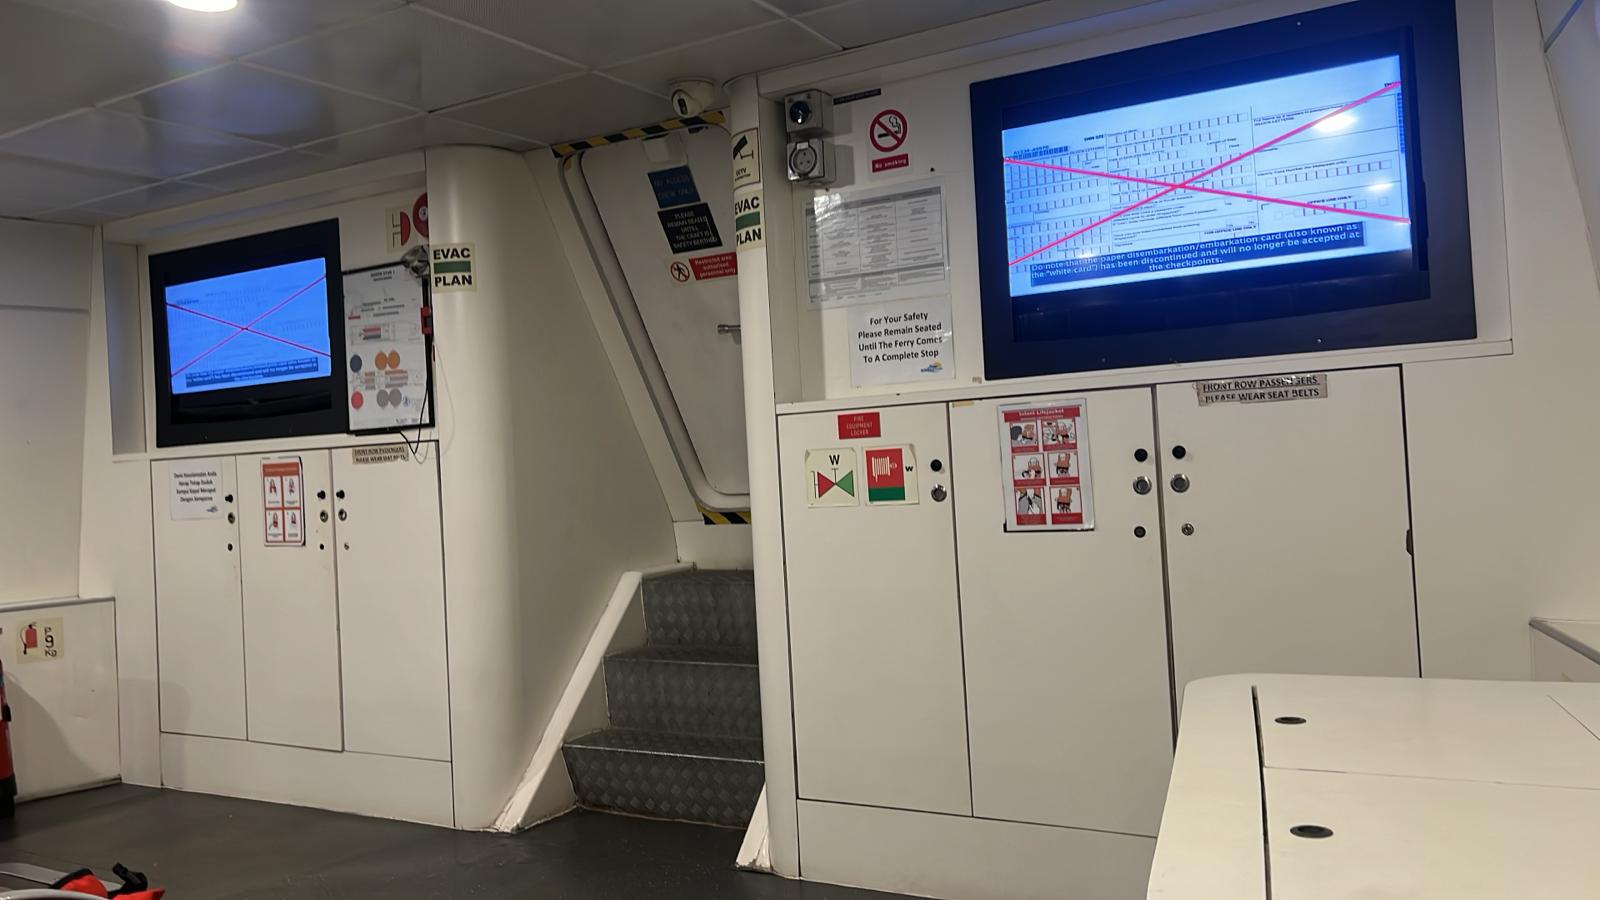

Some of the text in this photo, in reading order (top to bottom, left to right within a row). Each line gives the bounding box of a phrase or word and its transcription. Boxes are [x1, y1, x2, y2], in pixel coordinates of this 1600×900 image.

[735, 196, 760, 215] EVAC
[434, 248, 470, 260] EVAC
[1046, 262, 1064, 270] note
[1066, 259, 1082, 268] that
[1083, 257, 1098, 265] the
[1101, 254, 1125, 264] paper
[1260, 232, 1282, 242] card
[1284, 228, 1308, 240] (also
[1310, 225, 1343, 236] known
[1032, 270, 1044, 278] the
[1100, 262, 1115, 270] has
[1118, 260, 1138, 268] been
[1140, 251, 1198, 265] discontinued
[1200, 248, 1218, 257] and
[1220, 246, 1236, 255] will
[1254, 241, 1285, 252] longer
[1288, 238, 1300, 246] be
[1302, 234, 1346, 246] accepted
[1150, 257, 1223, 271] the checkpoints.
[434, 275, 472, 287] PLAN
[870, 312, 928, 326] For Your Safety
[858, 322, 942, 340] Please Remain Seated
[858, 336, 942, 352] Until The Ferry Comes
[882, 350, 919, 362] Complete
[920, 348, 939, 358] Stop
[1203, 382, 1232, 392] FRONT
[1234, 380, 1258, 390] ROW
[1206, 388, 1320, 402] PLEASE WEAR SEAT BELTS
[829, 454, 840, 466] W
[45, 635, 54, 648] 9
